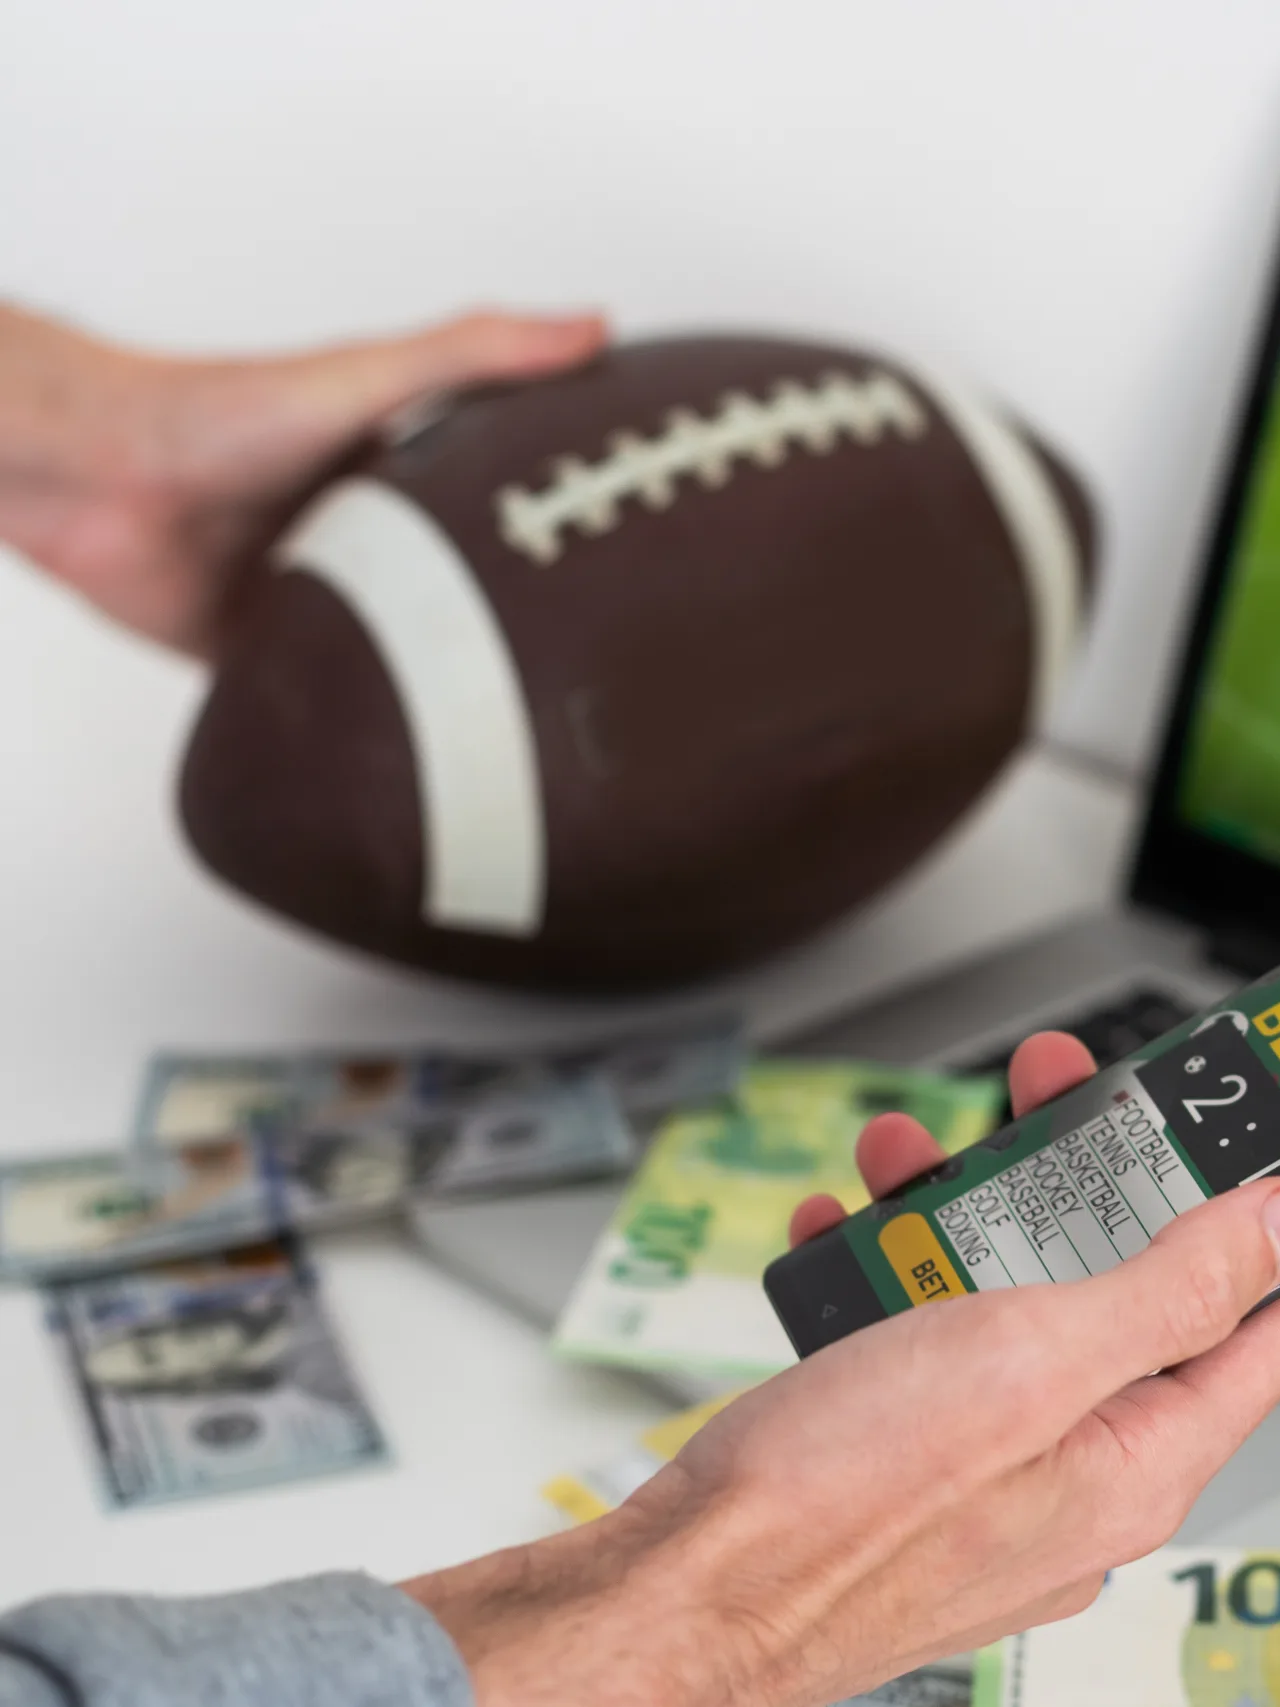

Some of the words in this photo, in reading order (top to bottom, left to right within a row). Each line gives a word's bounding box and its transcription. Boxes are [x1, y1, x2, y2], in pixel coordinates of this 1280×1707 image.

[1087, 1114, 1138, 1177] TENNIS
[1113, 1097, 1181, 1184] FOOTBALL
[967, 1183, 1013, 1228] GOLF
[997, 1165, 1061, 1252] BASEBALL
[1026, 1147, 1085, 1217] HOCKEY
[1054, 1132, 1132, 1236] BASKETBALL
[938, 1200, 990, 1267] BOXING
[910, 1258, 950, 1300] BET
